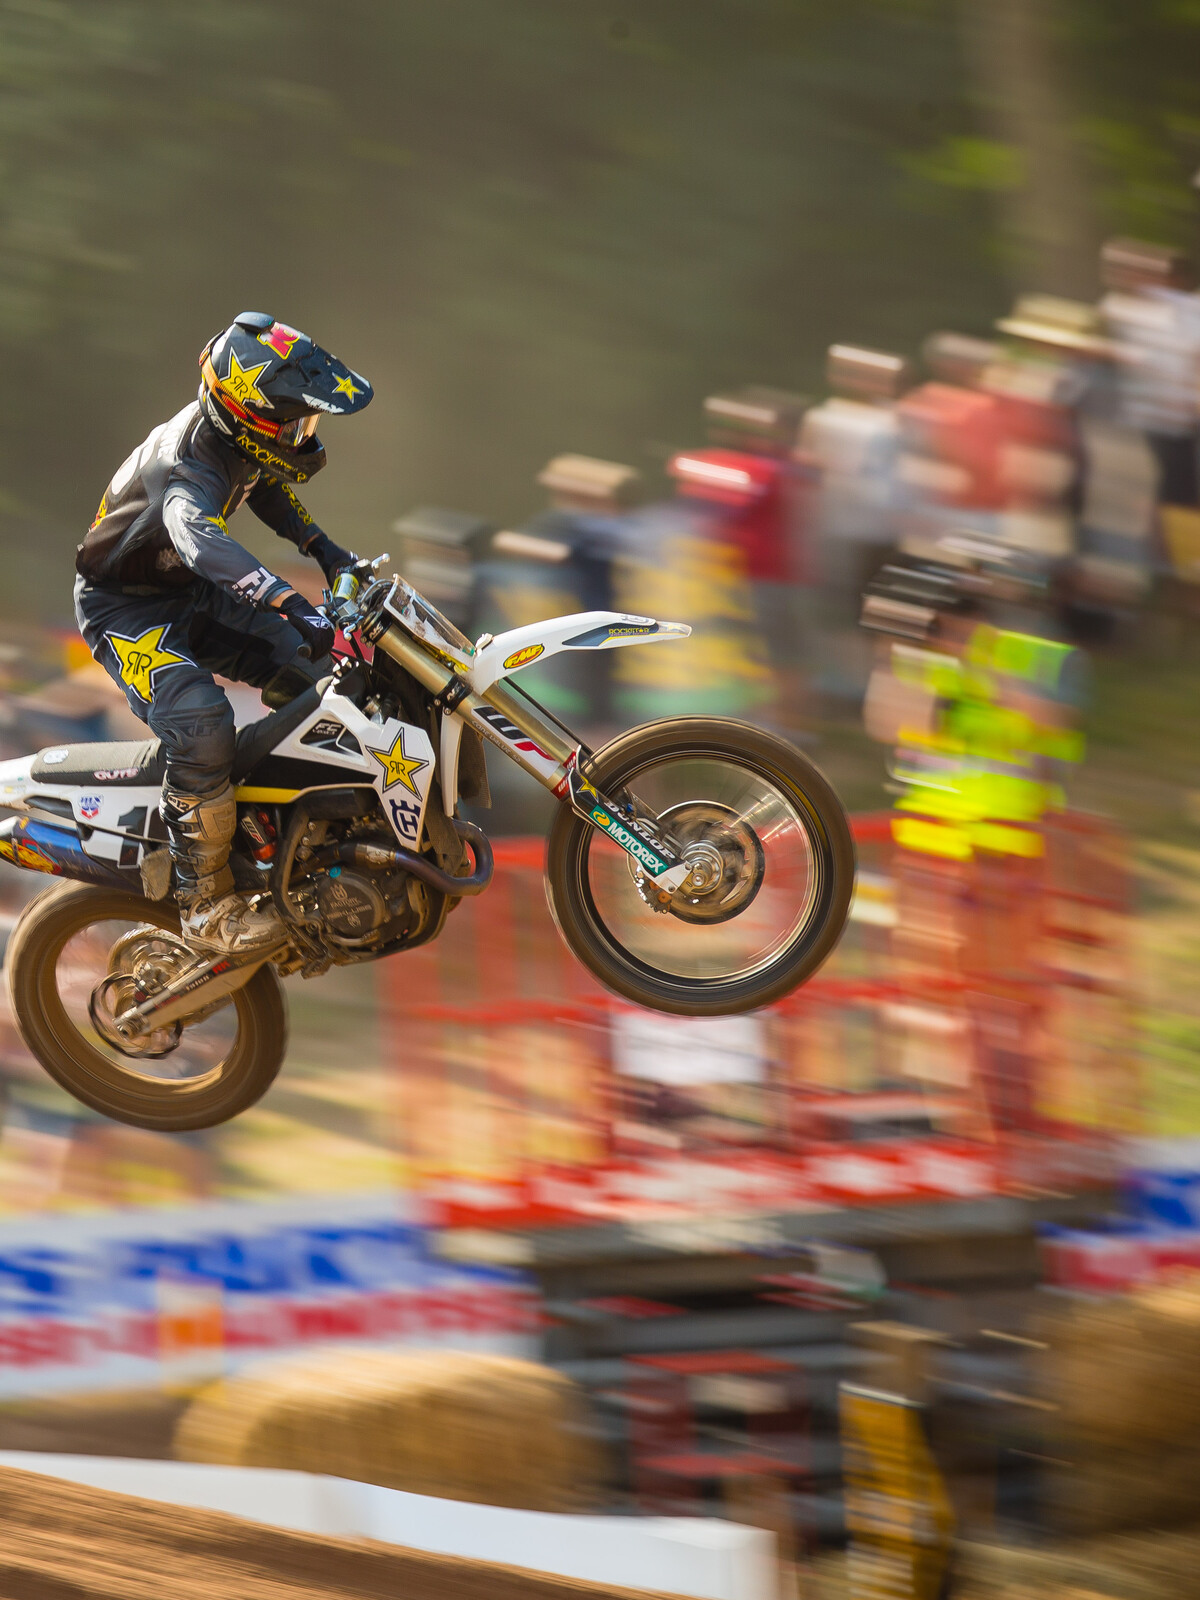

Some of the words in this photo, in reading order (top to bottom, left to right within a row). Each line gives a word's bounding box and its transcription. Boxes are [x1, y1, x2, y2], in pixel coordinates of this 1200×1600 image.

[236, 434, 306, 483] ROCKR
[506, 645, 543, 668] FMF
[604, 800, 676, 859] DUNLOP
[607, 821, 665, 874] MOTOREX
